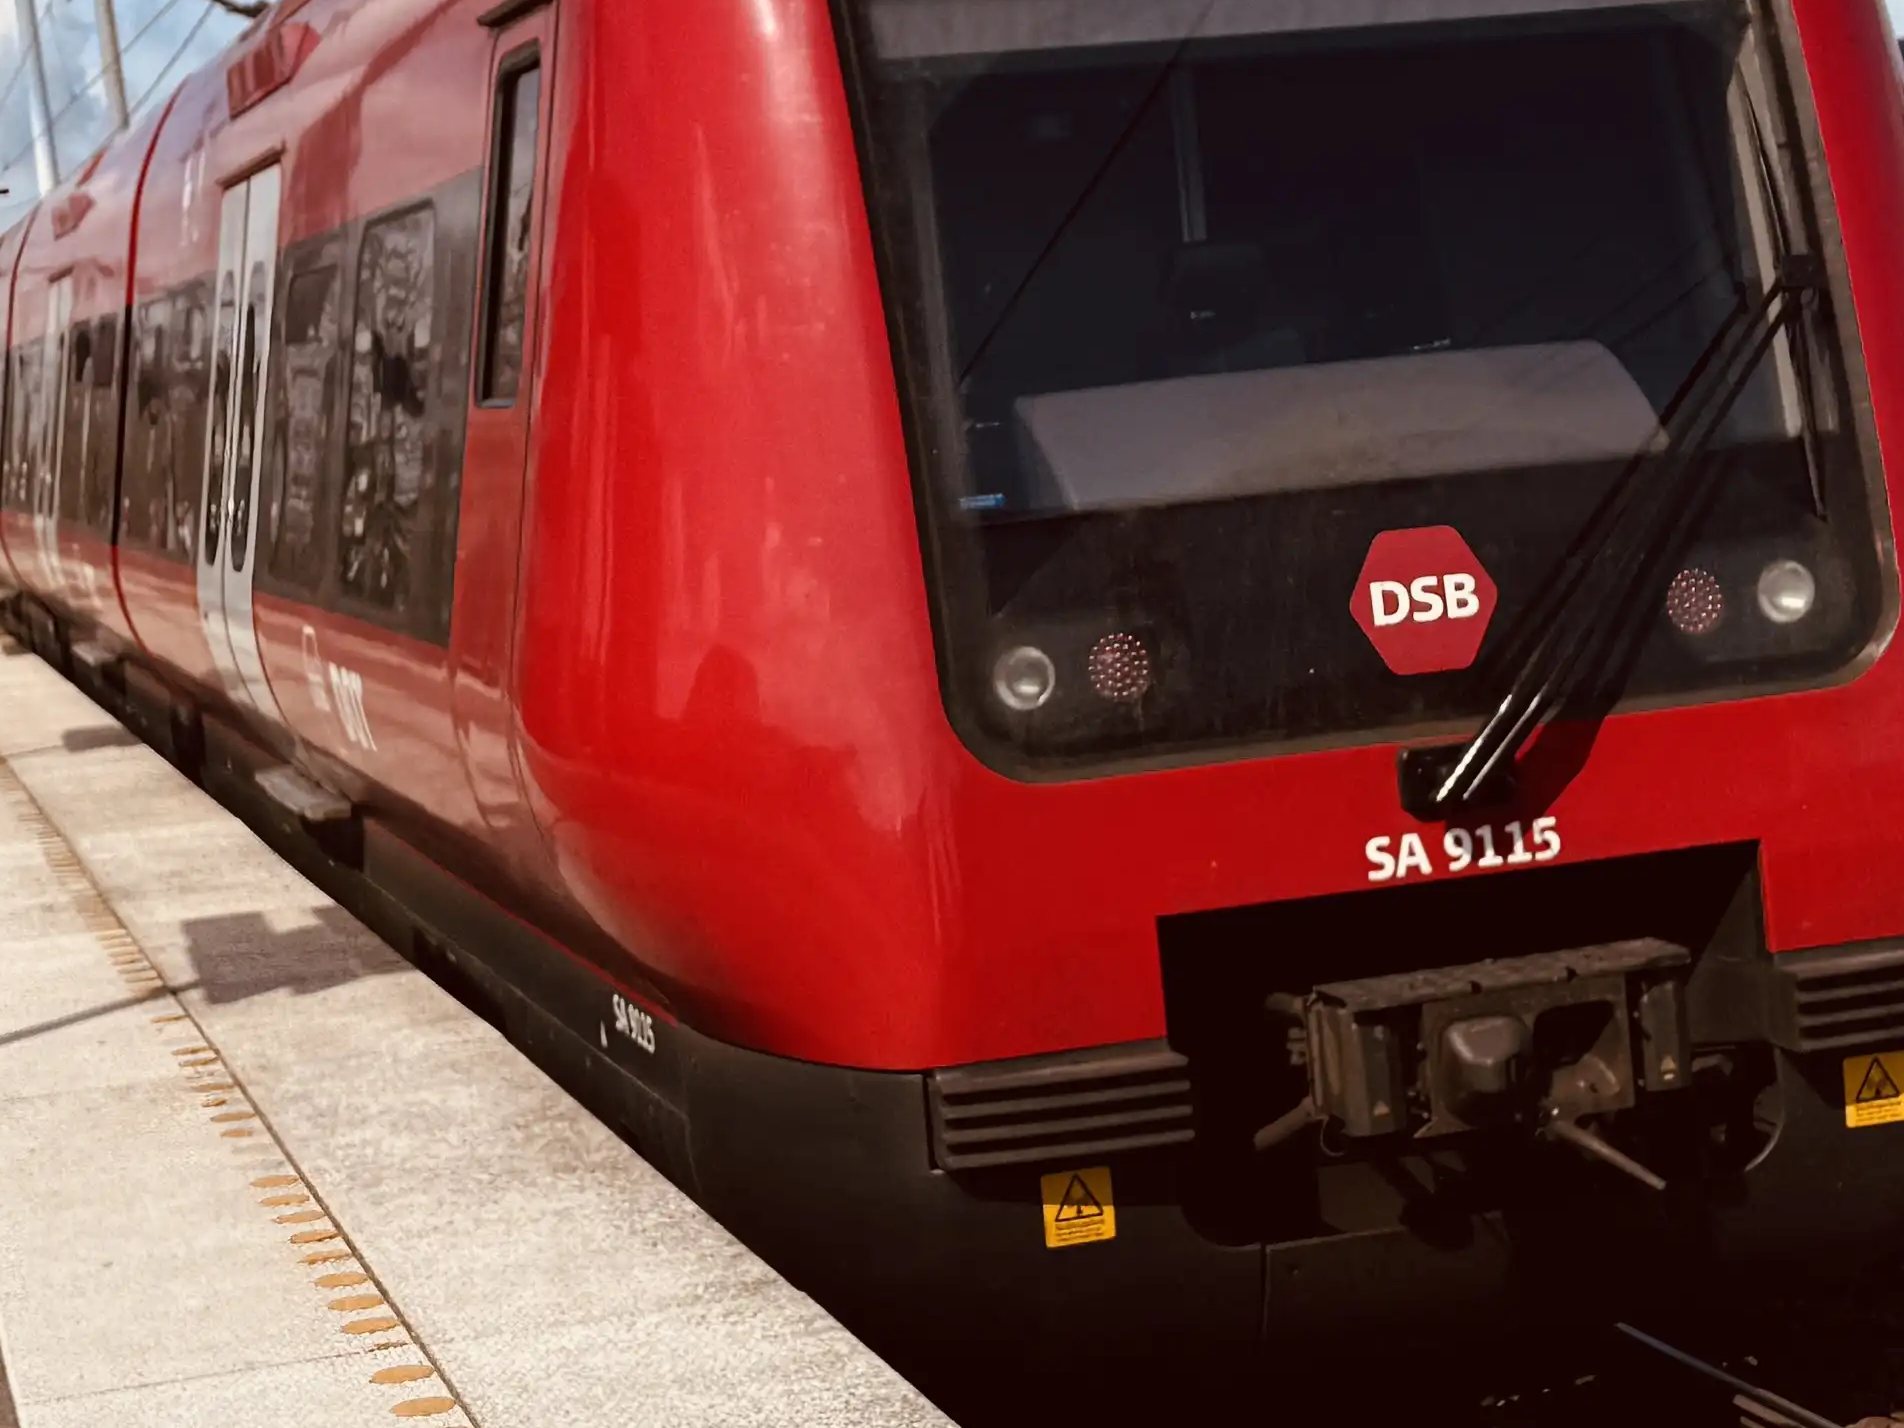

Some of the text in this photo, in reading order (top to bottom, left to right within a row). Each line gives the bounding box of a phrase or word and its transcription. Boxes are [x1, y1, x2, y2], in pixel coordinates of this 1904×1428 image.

[1369, 573, 1480, 627] DSB
[1365, 816, 1561, 881] SA 9115
